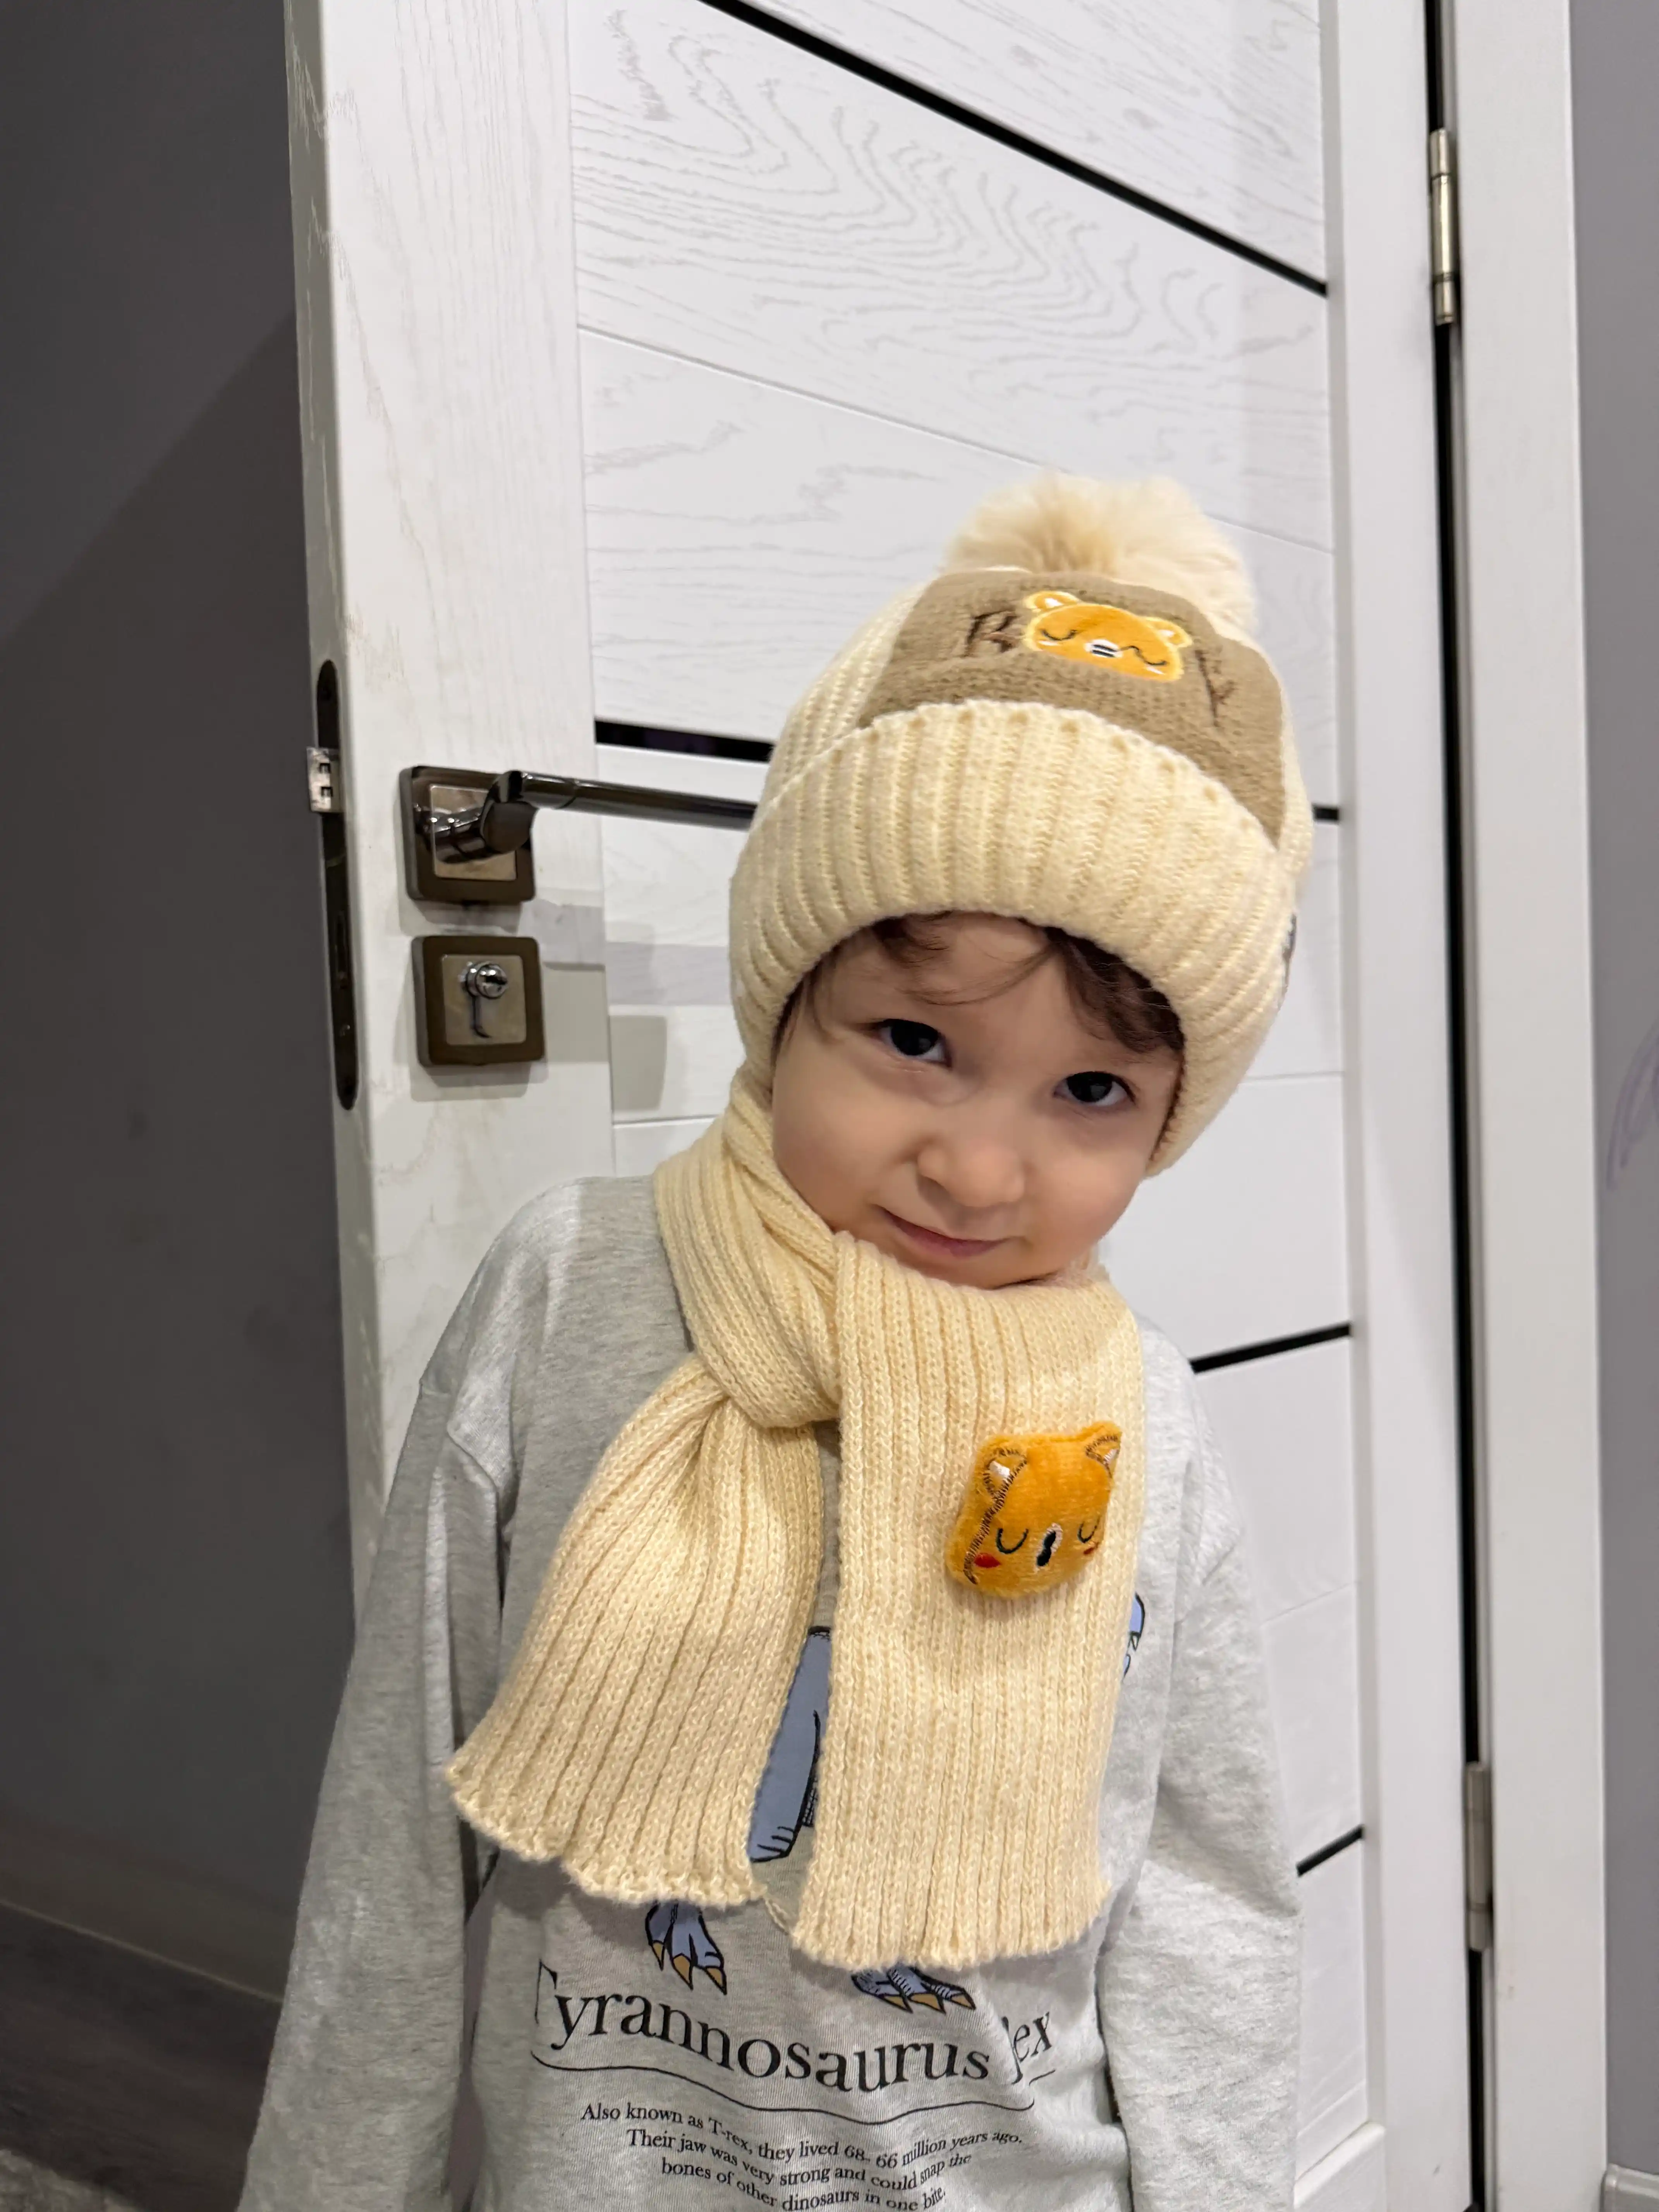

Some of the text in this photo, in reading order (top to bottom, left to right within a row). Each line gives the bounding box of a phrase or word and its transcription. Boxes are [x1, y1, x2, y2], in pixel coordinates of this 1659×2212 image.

[1001, 2011, 1052, 2085] ex
[580, 2102, 621, 2120] Also
[625, 2102, 683, 2124] known
[688, 2116, 703, 2130] as
[708, 2116, 752, 2155] T-rex,
[758, 2142, 795, 2163] they
[800, 2141, 838, 2157] lived
[876, 2153, 897, 2169] 66
[902, 2140, 946, 2166] million
[950, 2132, 988, 2150] years
[627, 2129, 971, 2191] Their jaw was very strong and could snap the
[661, 2157, 711, 2179] bones
[716, 2172, 734, 2185] of
[737, 2181, 778, 2207] other
[782, 2189, 860, 2212] dinosaurs
[865, 2189, 880, 2203] in
[886, 2200, 918, 2210] one
